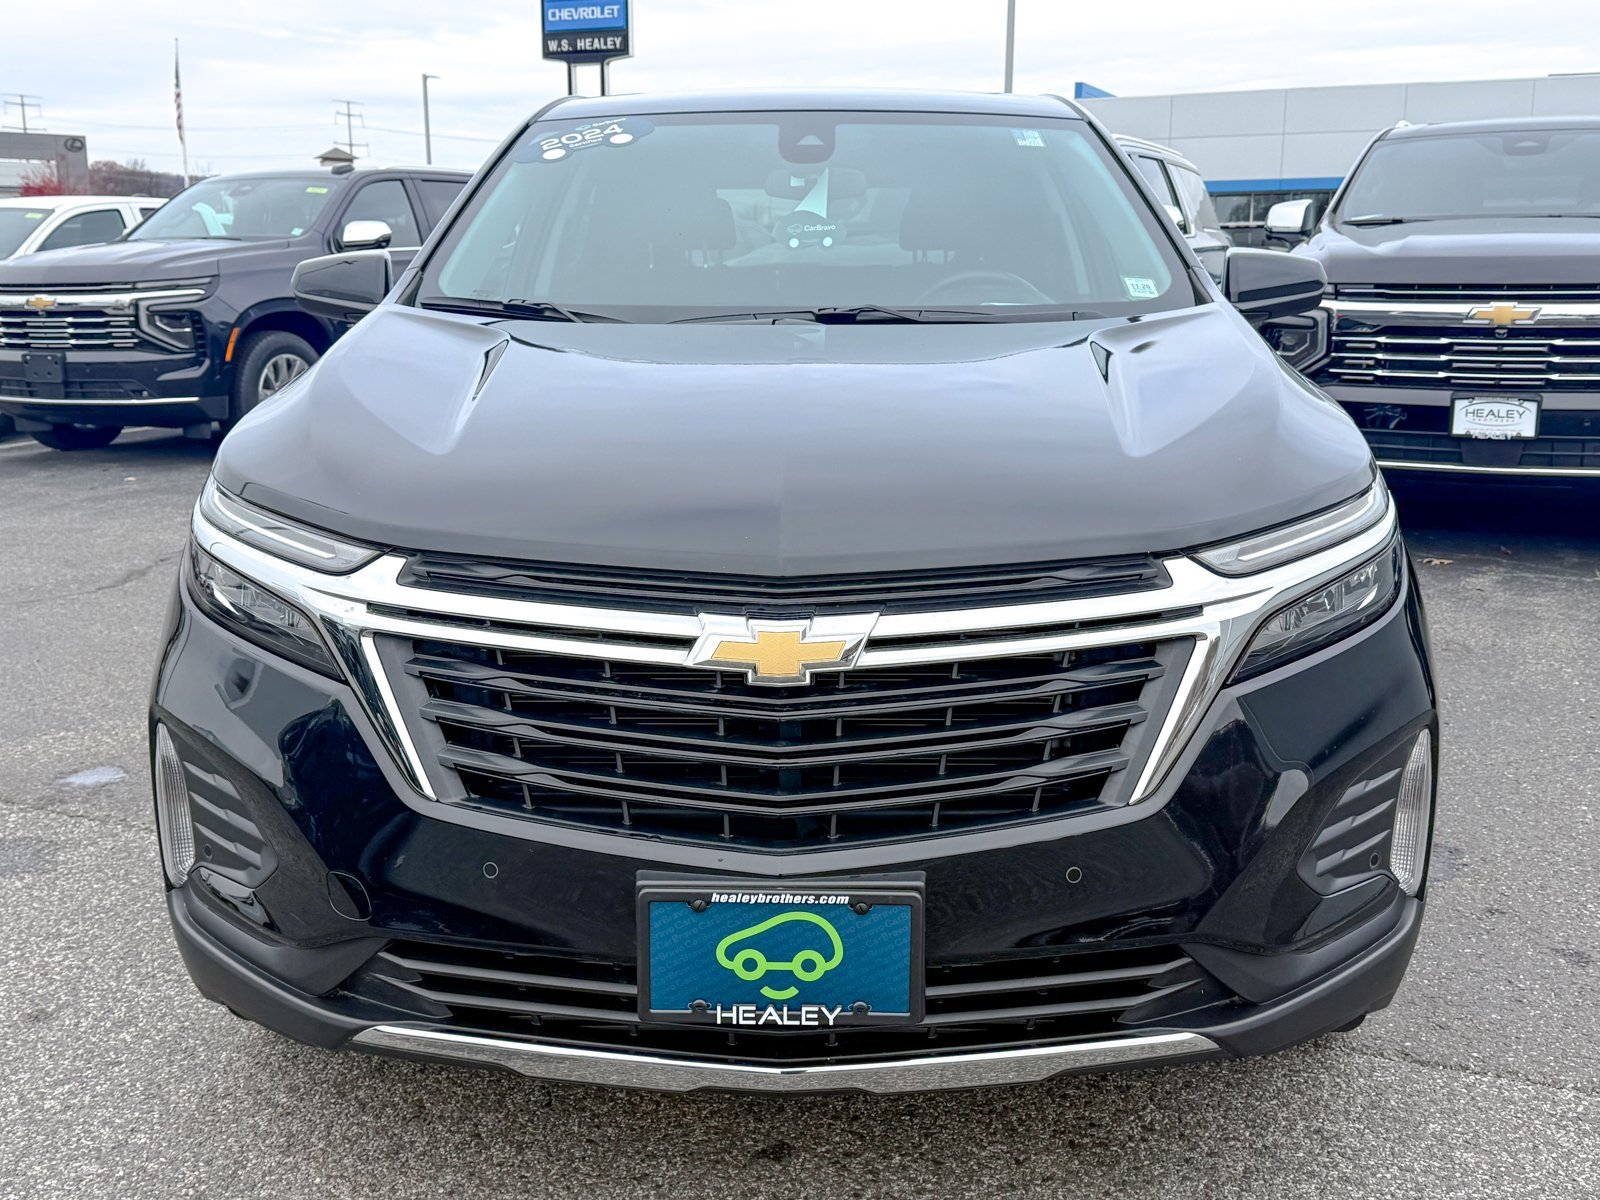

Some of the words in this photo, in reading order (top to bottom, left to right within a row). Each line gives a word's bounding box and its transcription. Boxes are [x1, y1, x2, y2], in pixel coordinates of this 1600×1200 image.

[547, 5, 620, 21] CHEVROLET
[547, 39, 573, 52] W.S.
[576, 36, 622, 51] HEALEY
[540, 124, 624, 151] 2024
[803, 224, 836, 232] CarBravo
[1465, 408, 1526, 419] HEALEY
[711, 892, 850, 905] healeybrothers.com
[715, 1004, 844, 1027] HEALEY
